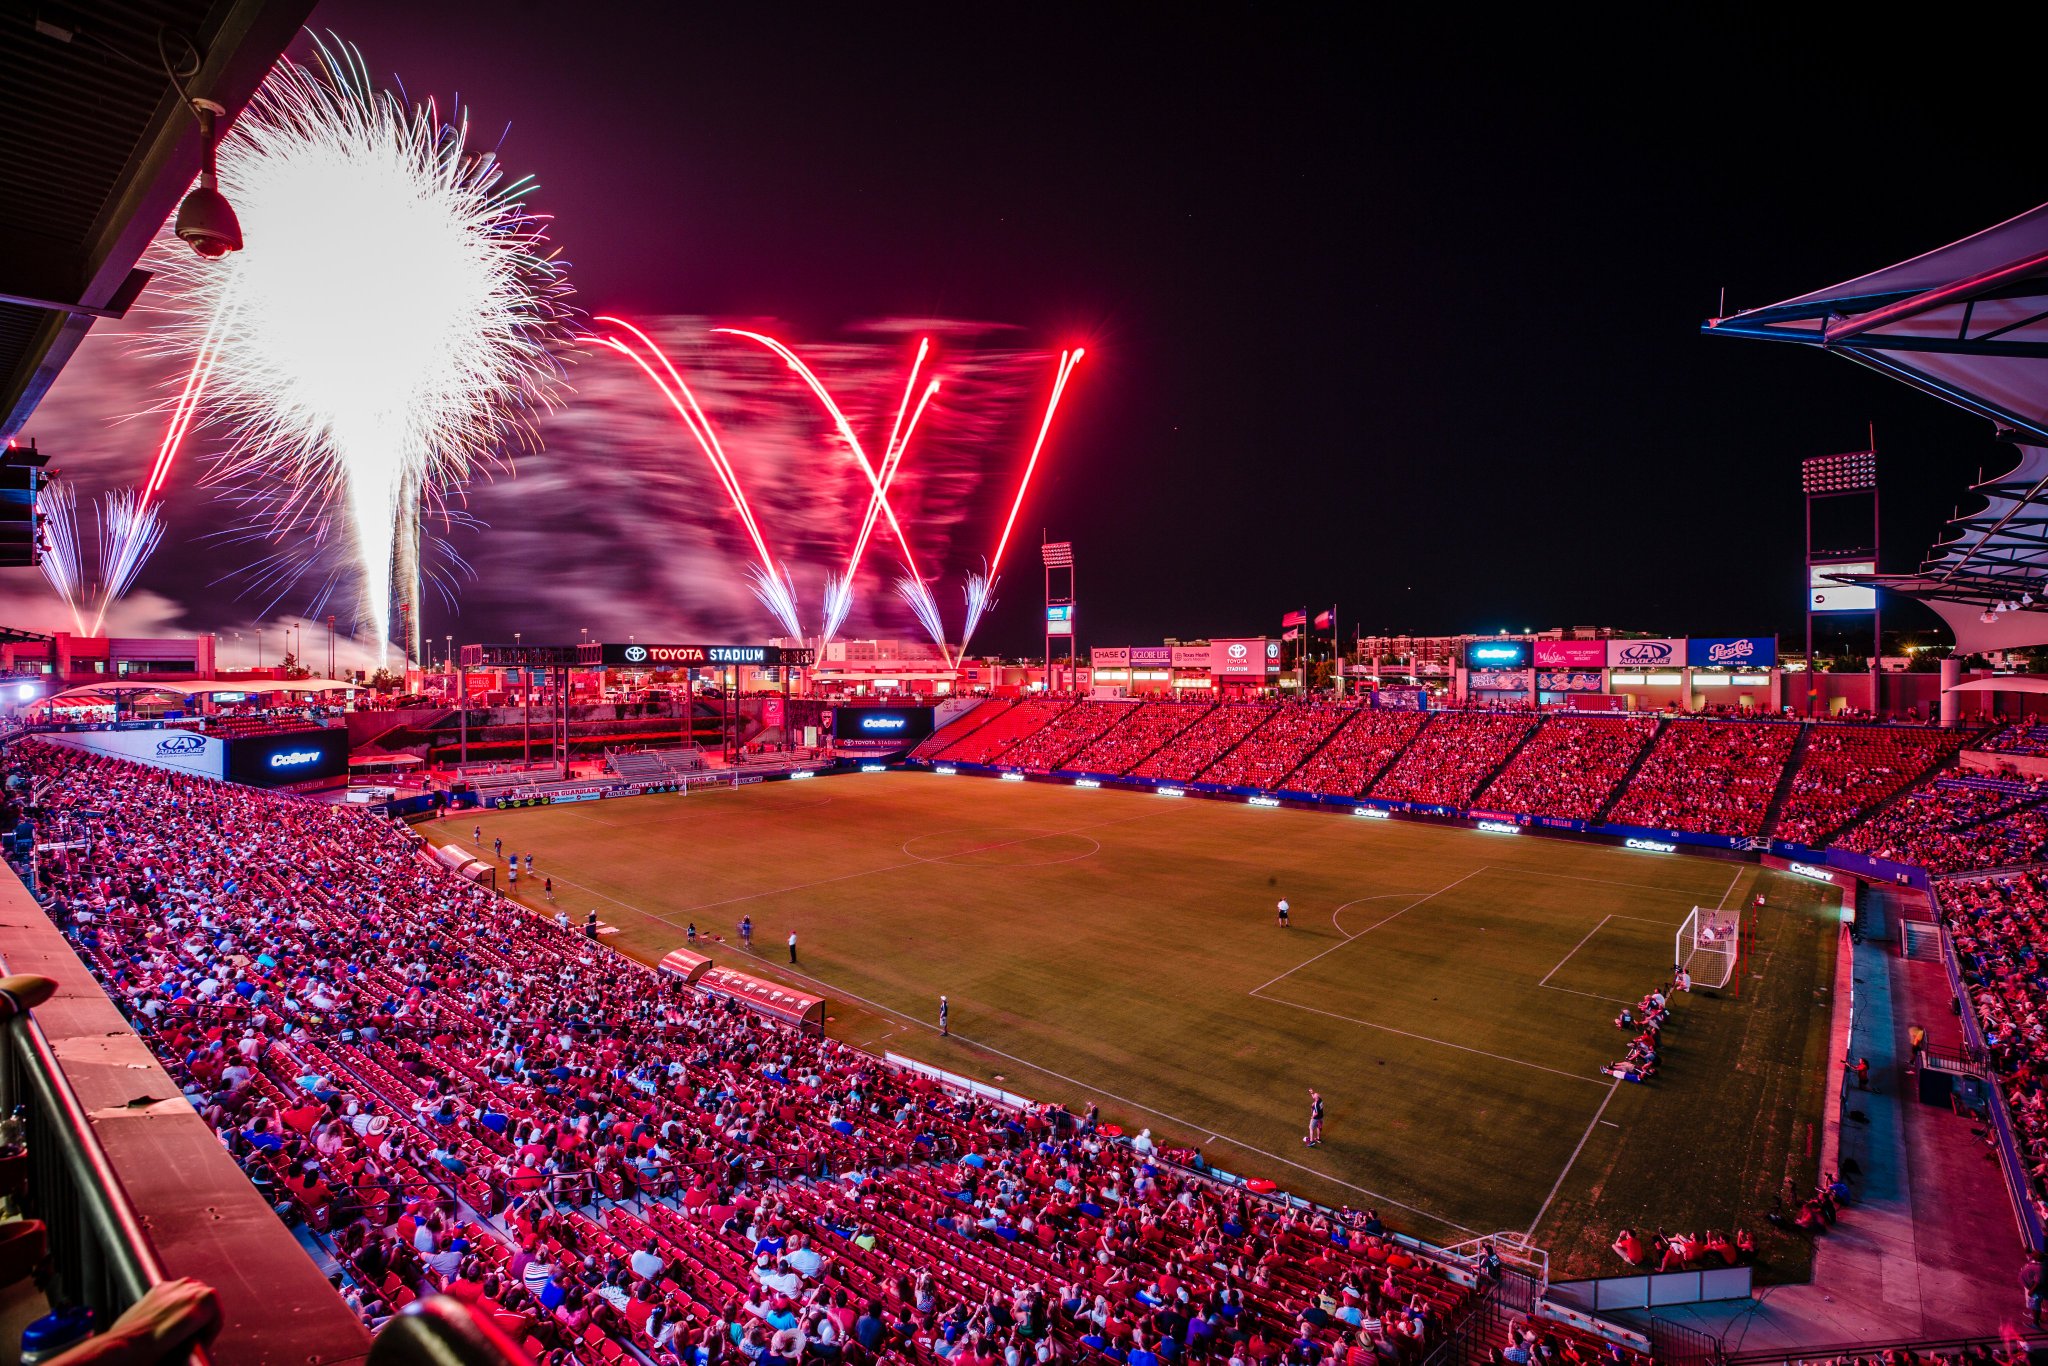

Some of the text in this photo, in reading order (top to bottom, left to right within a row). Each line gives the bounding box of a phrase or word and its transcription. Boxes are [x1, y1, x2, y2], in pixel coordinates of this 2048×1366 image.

[650, 649, 764, 661] TOYOTA STADIUM
[1094, 650, 1118, 658] CHASE
[1136, 650, 1169, 659] GLOBE LIFE
[1619, 657, 1671, 665] ADVOCARE
[863, 718, 905, 728] CoServ
[157, 747, 205, 755] ADVOCARE
[271, 751, 320, 767] CoServ
[273, 780, 324, 793] OYOTA STADIUM
[1075, 779, 1100, 788] CoServ
[513, 792, 541, 800] DALLAS
[561, 787, 600, 796] GUARDIANS
[1158, 787, 1184, 796] CoServ
[1249, 797, 1279, 806] CoServ
[1355, 808, 1389, 818] CoServ
[1478, 821, 1520, 834] CoServ
[1626, 838, 1676, 852] CoServ
[1790, 862, 1834, 881] CoServ
[477, 1037, 482, 1045] 9
[526, 1094, 533, 1103] 6
